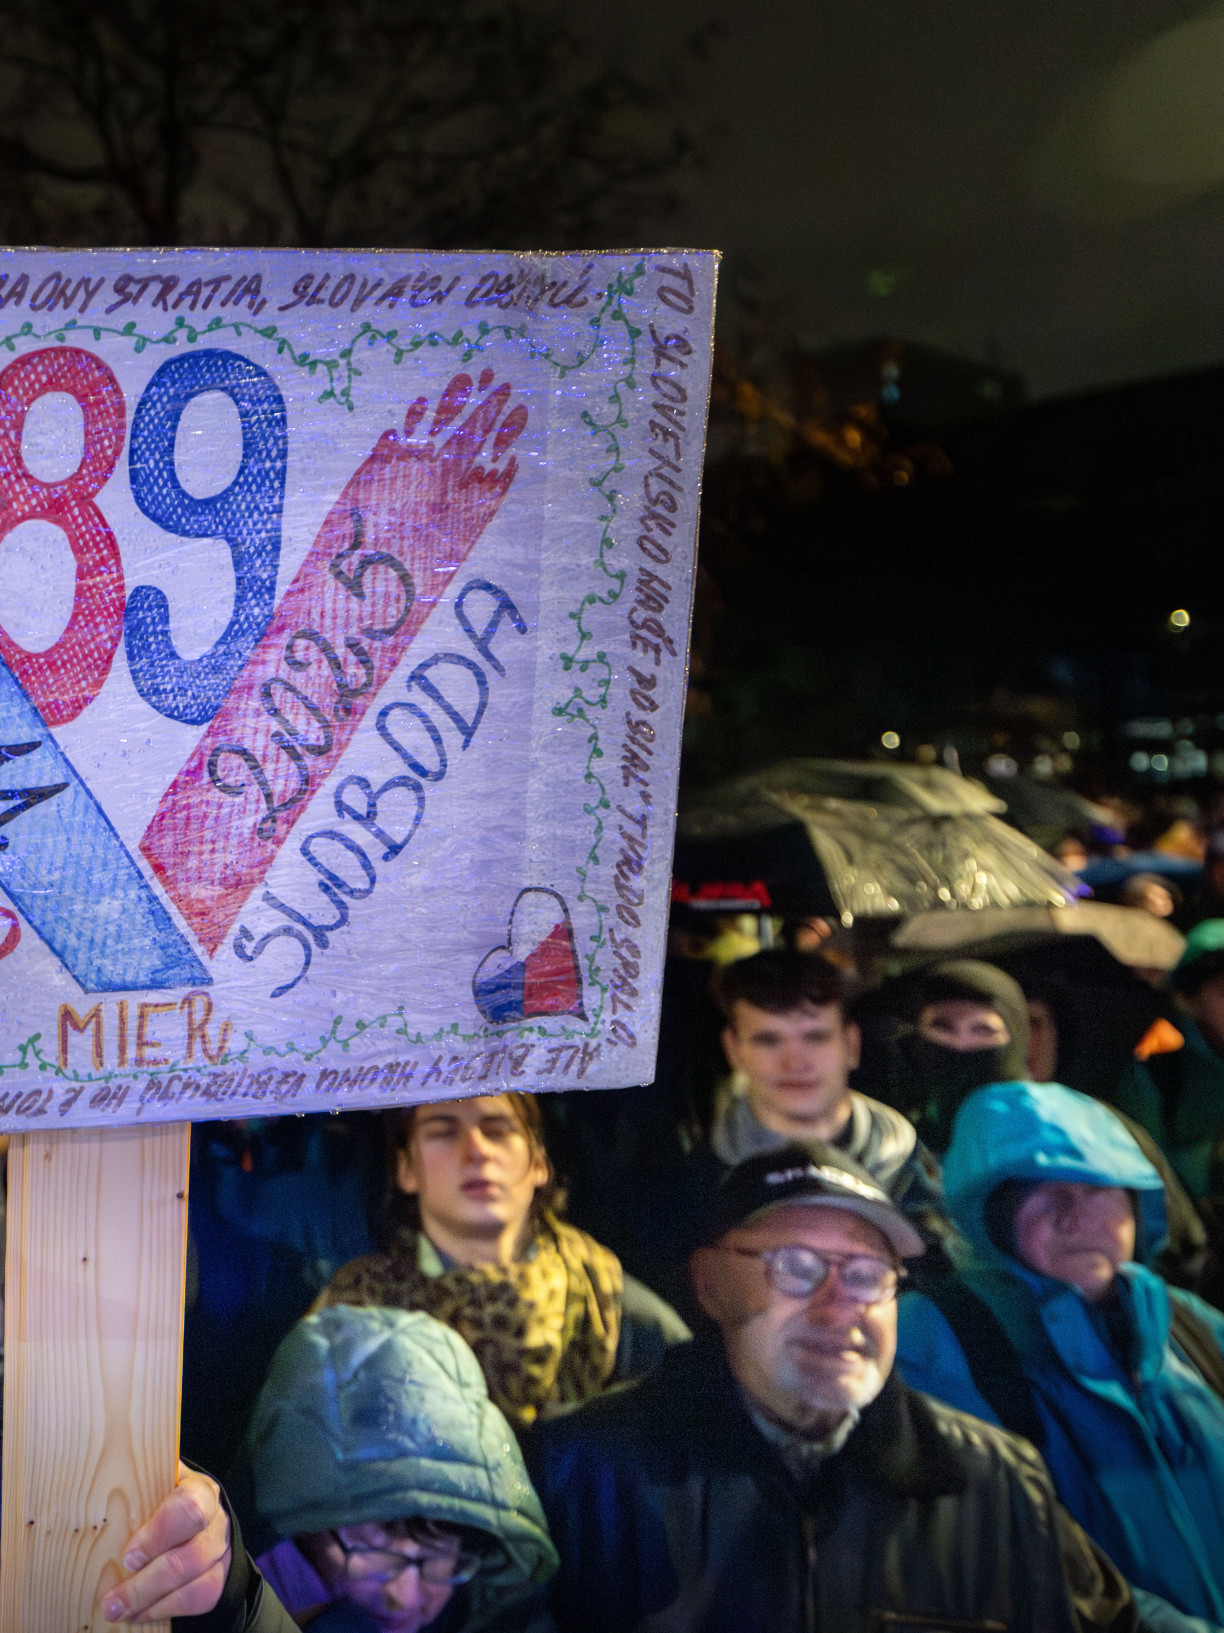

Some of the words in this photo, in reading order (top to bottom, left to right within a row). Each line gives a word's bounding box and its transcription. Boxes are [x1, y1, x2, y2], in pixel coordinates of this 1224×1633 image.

[654, 261, 695, 314] TO
[636, 322, 693, 564] SLOVENSKO
[628, 567, 678, 667] NAŠE
[208, 506, 416, 840] 2025
[233, 578, 529, 998] SLOBODA
[58, 990, 233, 1070] MIER
[536, 1042, 601, 1080] ALE
